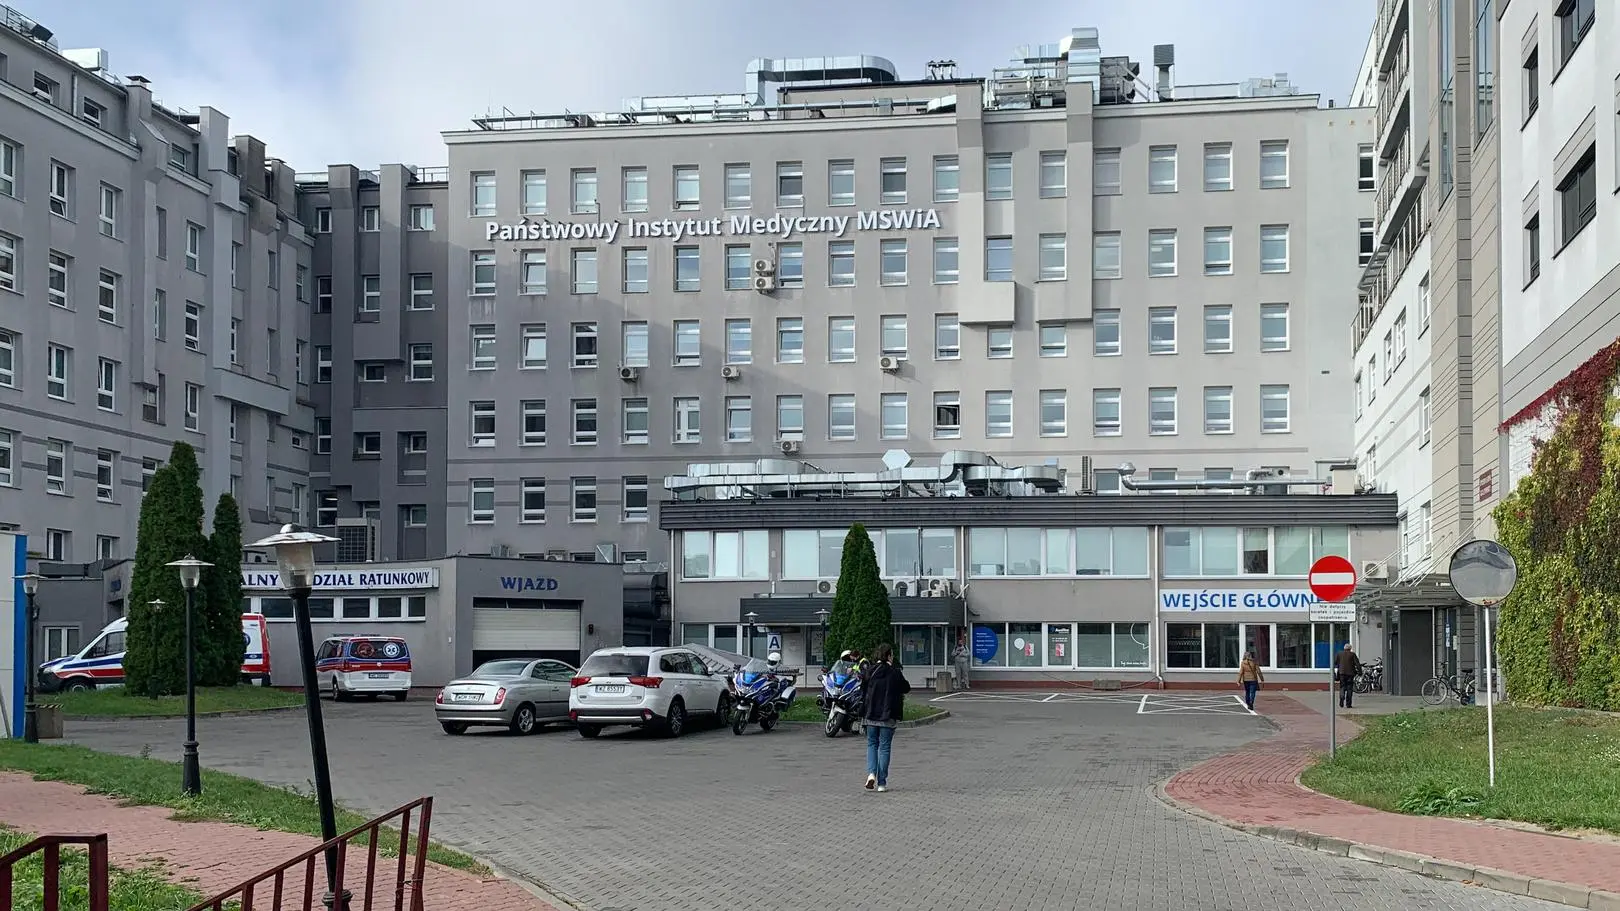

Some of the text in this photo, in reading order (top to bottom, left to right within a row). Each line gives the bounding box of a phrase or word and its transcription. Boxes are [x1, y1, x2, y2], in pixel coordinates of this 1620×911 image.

[485, 208, 941, 243] Państwowy Instytut Medyczny MSWiA
[312, 573, 355, 586] DZIAŁ
[359, 571, 430, 586] RATUNKOWY
[500, 576, 558, 592] WJAZD
[1162, 589, 1237, 611] WEJŚCIE
[769, 636, 780, 649] A
